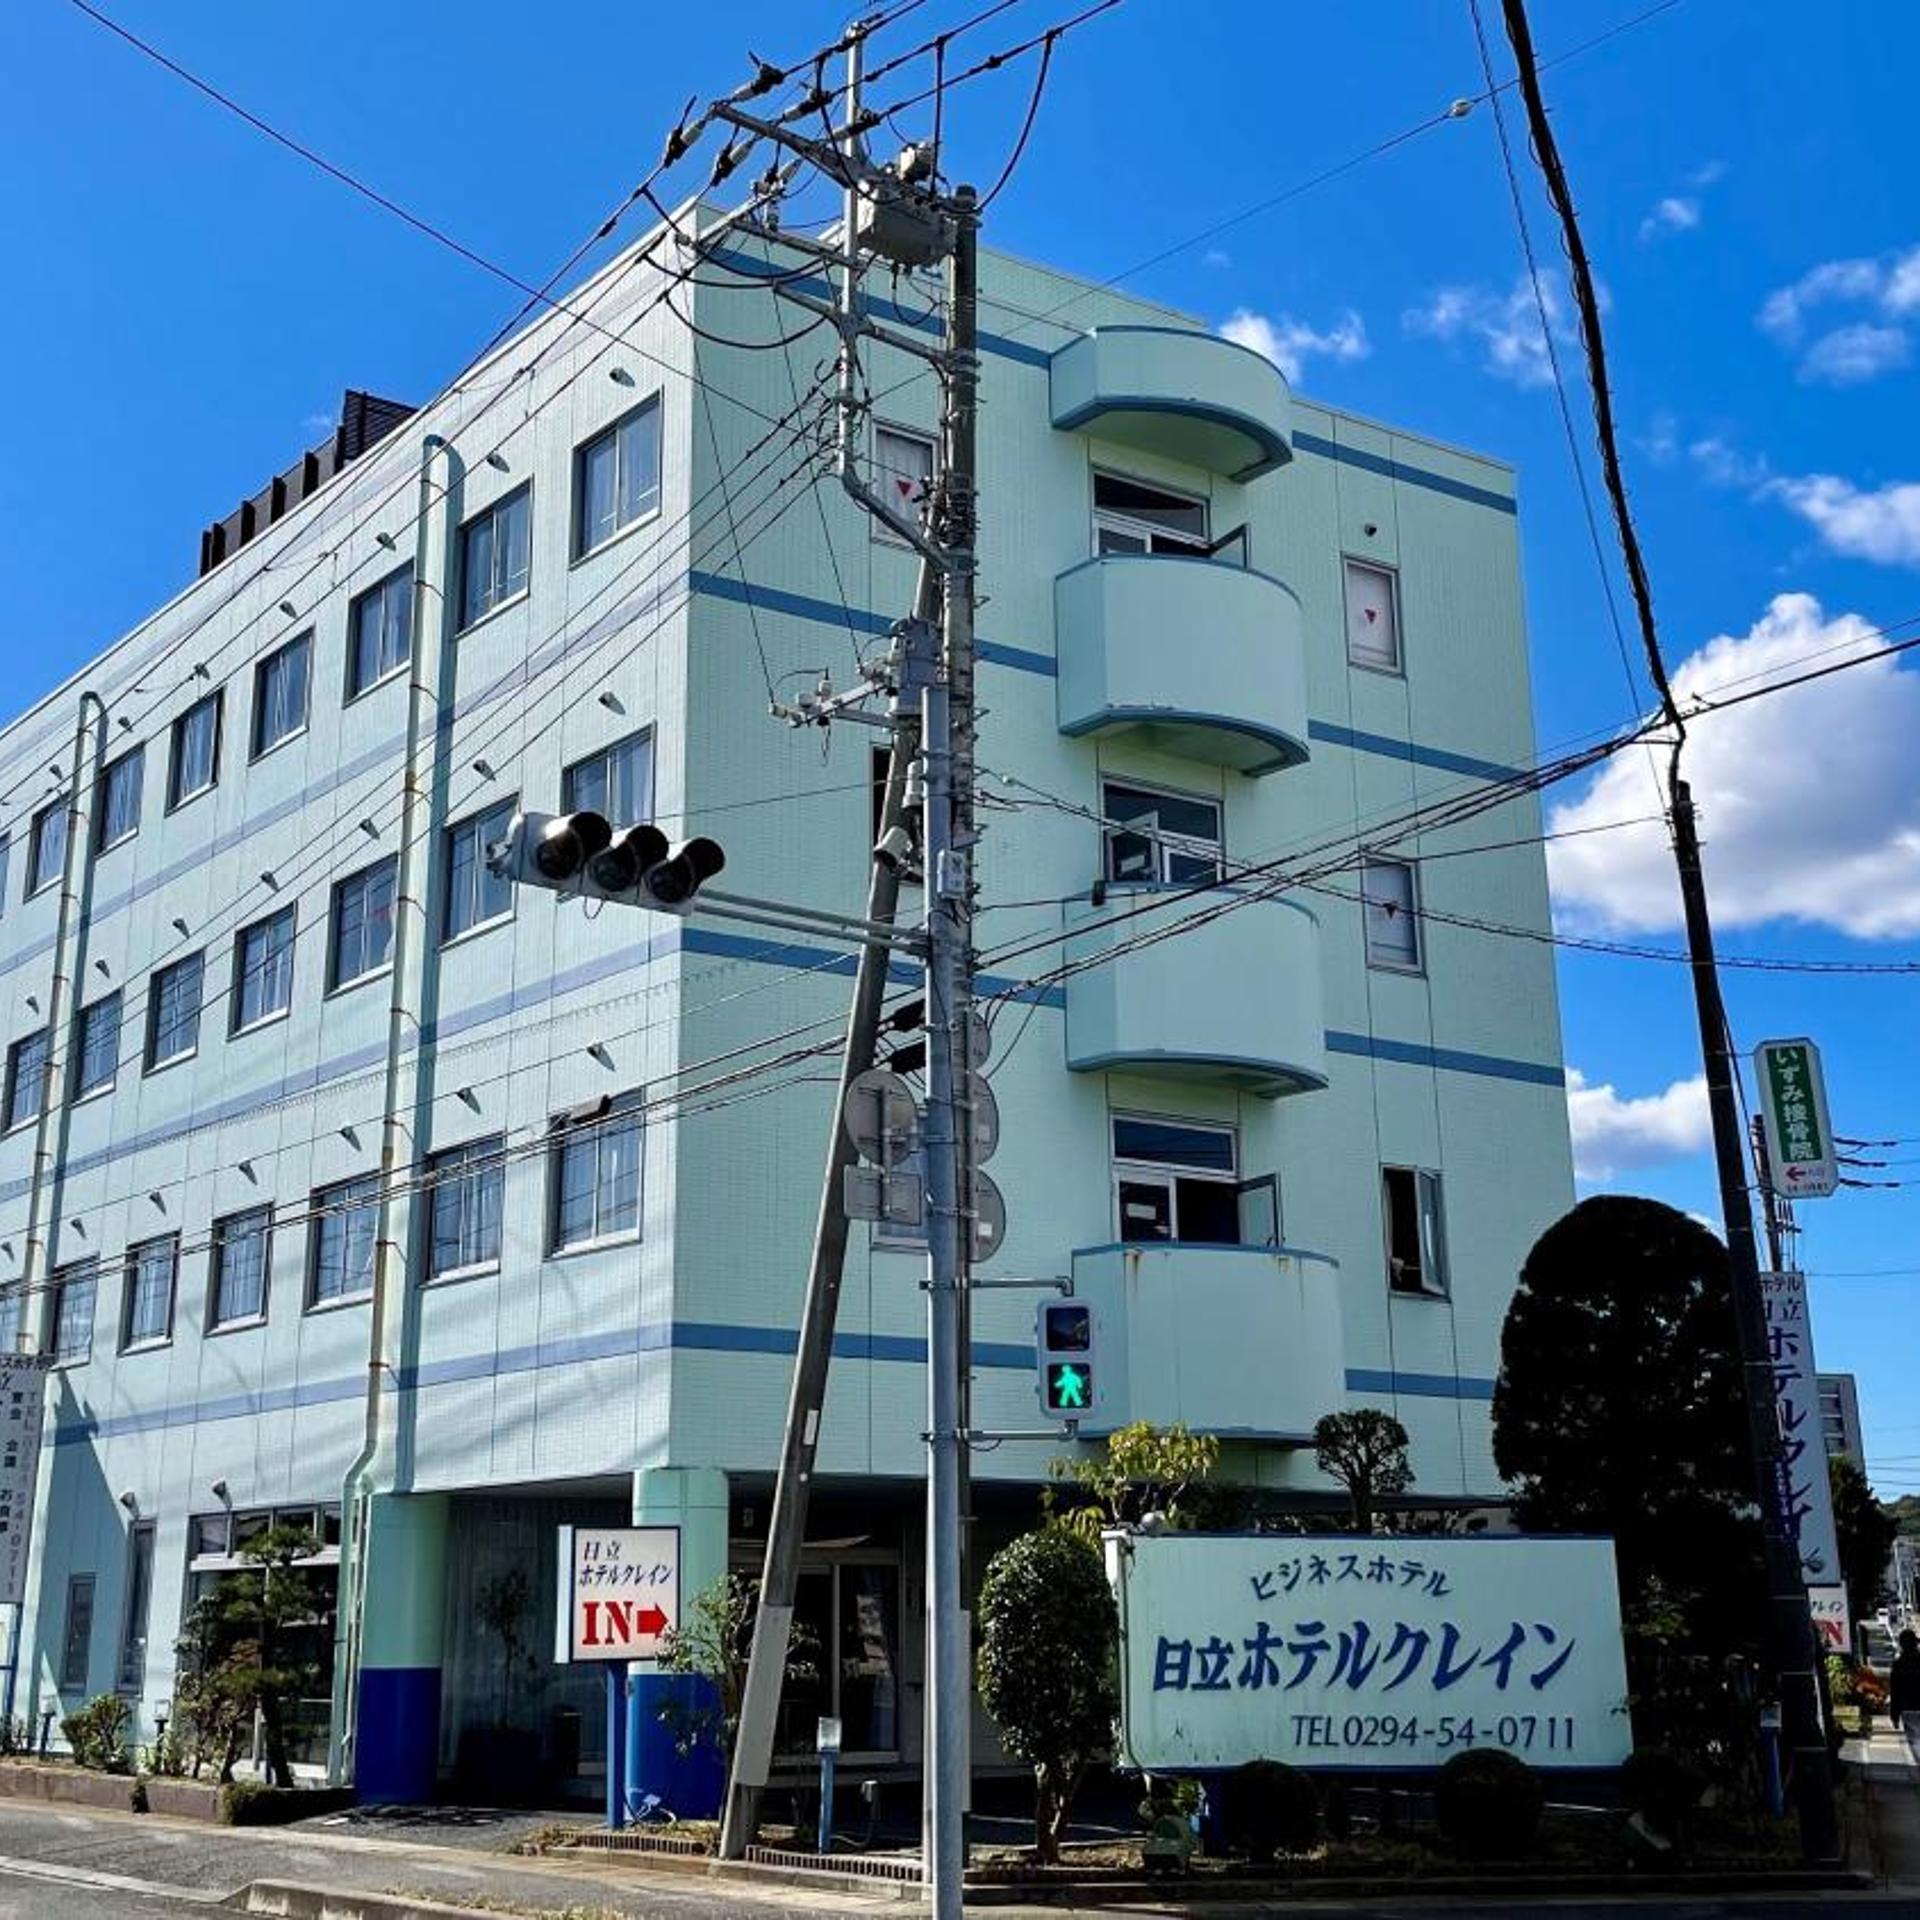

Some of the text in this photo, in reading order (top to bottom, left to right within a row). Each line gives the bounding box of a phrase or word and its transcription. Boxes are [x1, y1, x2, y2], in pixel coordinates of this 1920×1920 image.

[583, 1540, 622, 1561] 日立
[579, 1564, 673, 1586] ホテルクレイン
[1251, 1554, 1451, 1601] ビジネスホテル
[582, 1601, 634, 1645] IN
[1153, 1620, 1576, 1692] 日立ホテルクレイン
